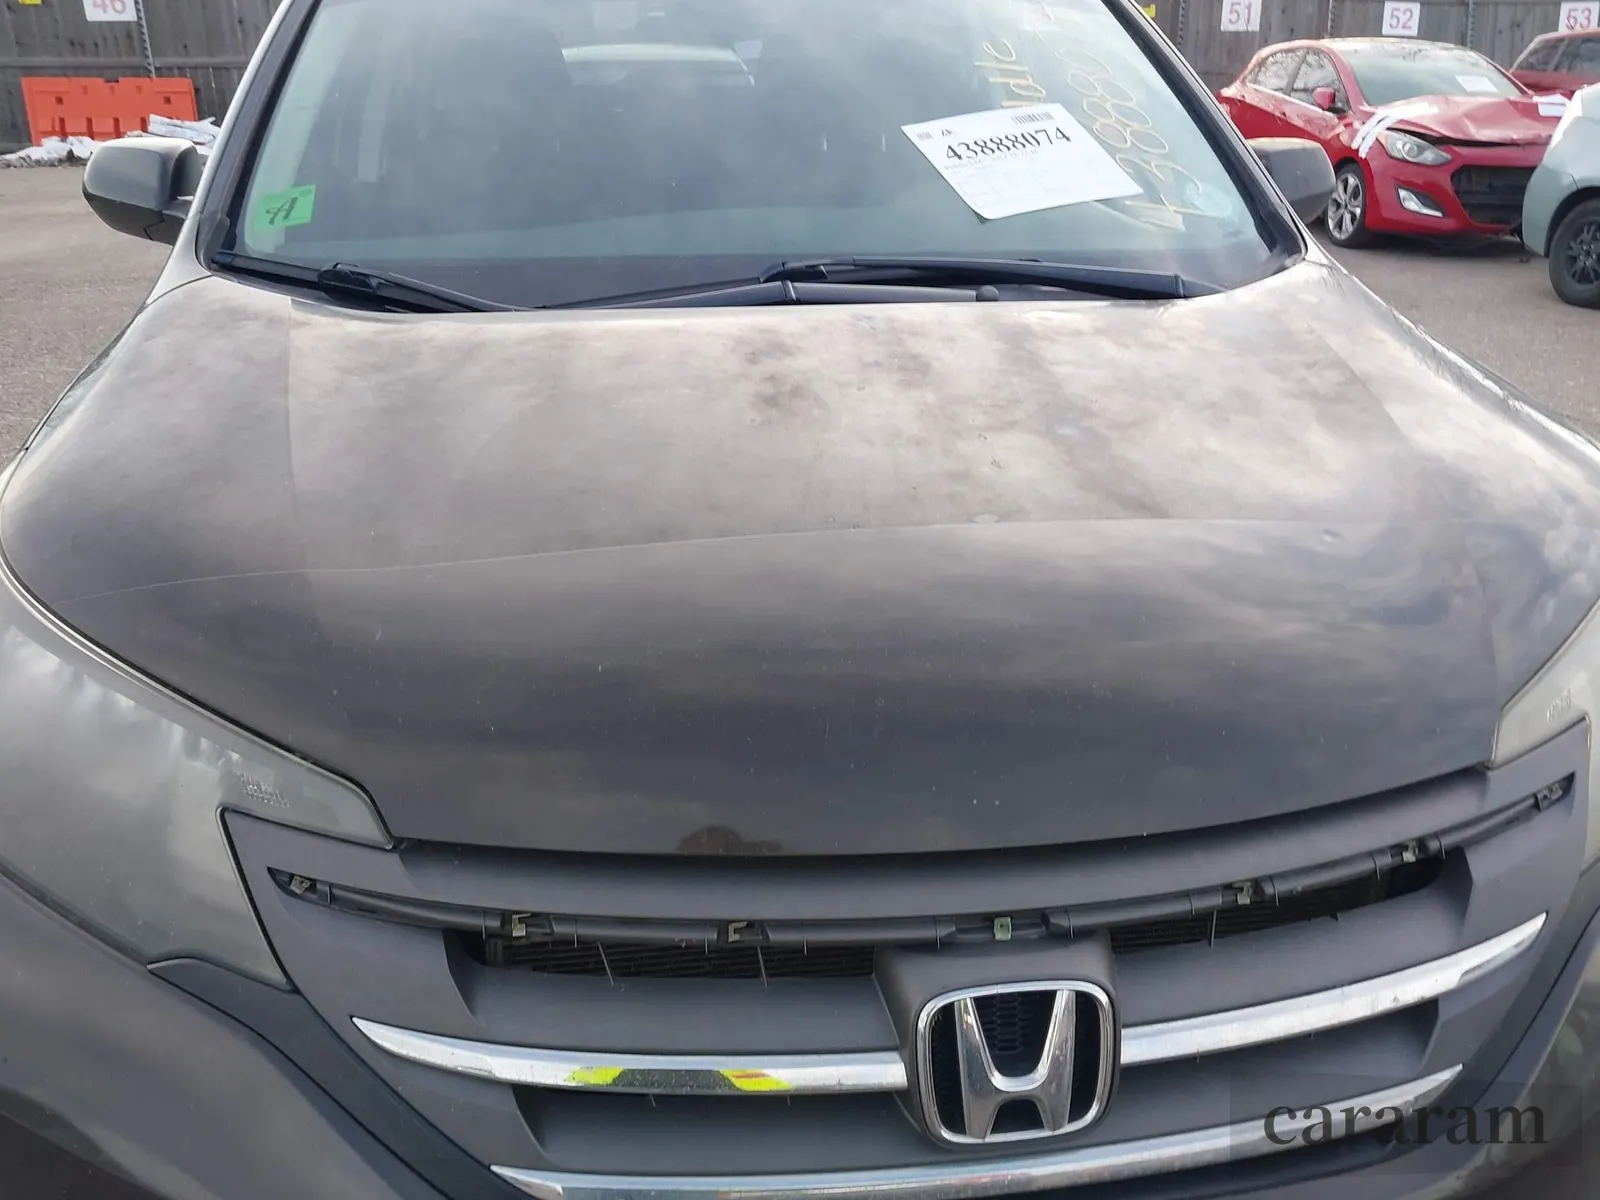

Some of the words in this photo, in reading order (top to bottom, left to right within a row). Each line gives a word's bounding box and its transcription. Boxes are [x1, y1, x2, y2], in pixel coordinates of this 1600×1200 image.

[1228, 0, 1253, 25] 51
[1388, 8, 1414, 30] 52
[1565, 7, 1592, 30] 53
[946, 126, 1072, 161] 43888074
